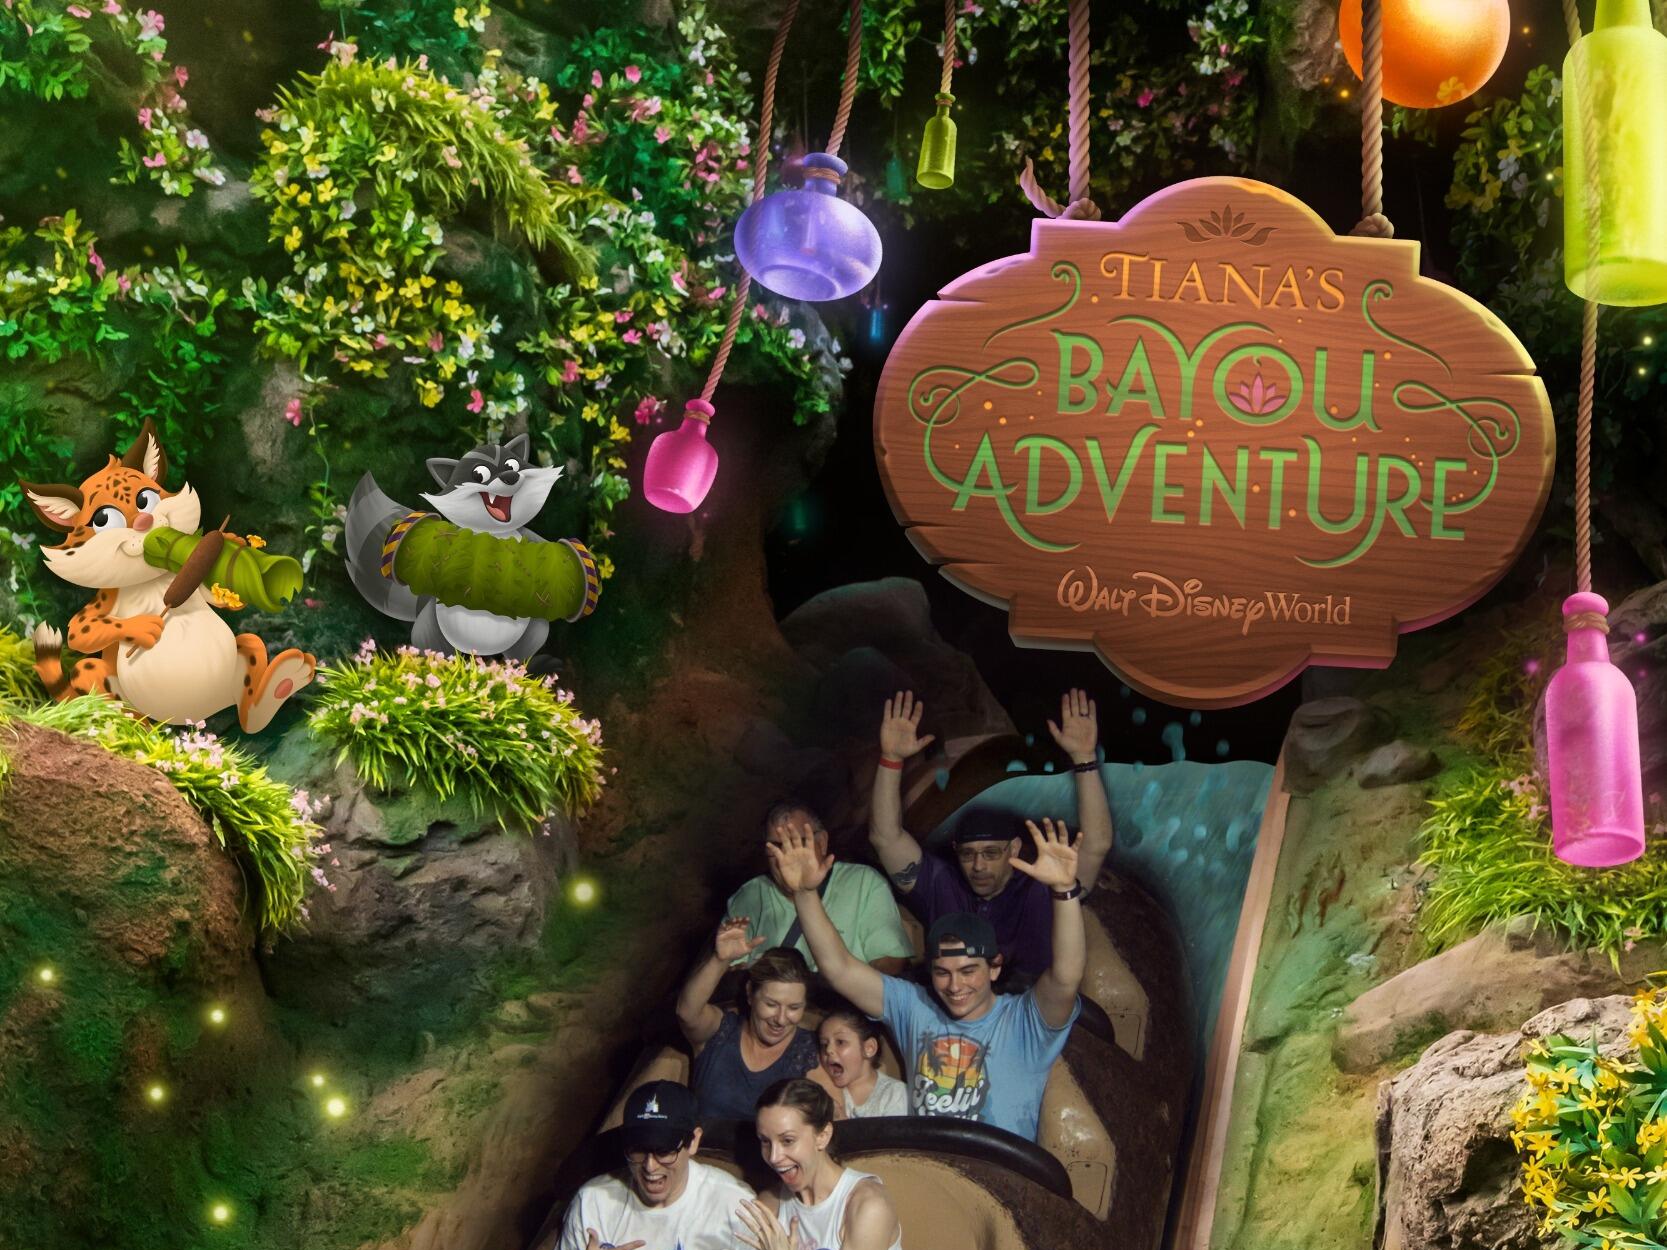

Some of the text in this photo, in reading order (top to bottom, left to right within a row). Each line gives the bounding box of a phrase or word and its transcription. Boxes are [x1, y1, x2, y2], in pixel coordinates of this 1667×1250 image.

[1099, 251, 1346, 313] TIANA'S
[1050, 314, 1382, 432] BAYOU
[951, 423, 1468, 568] ADVENTURE
[1264, 591, 1352, 625] World
